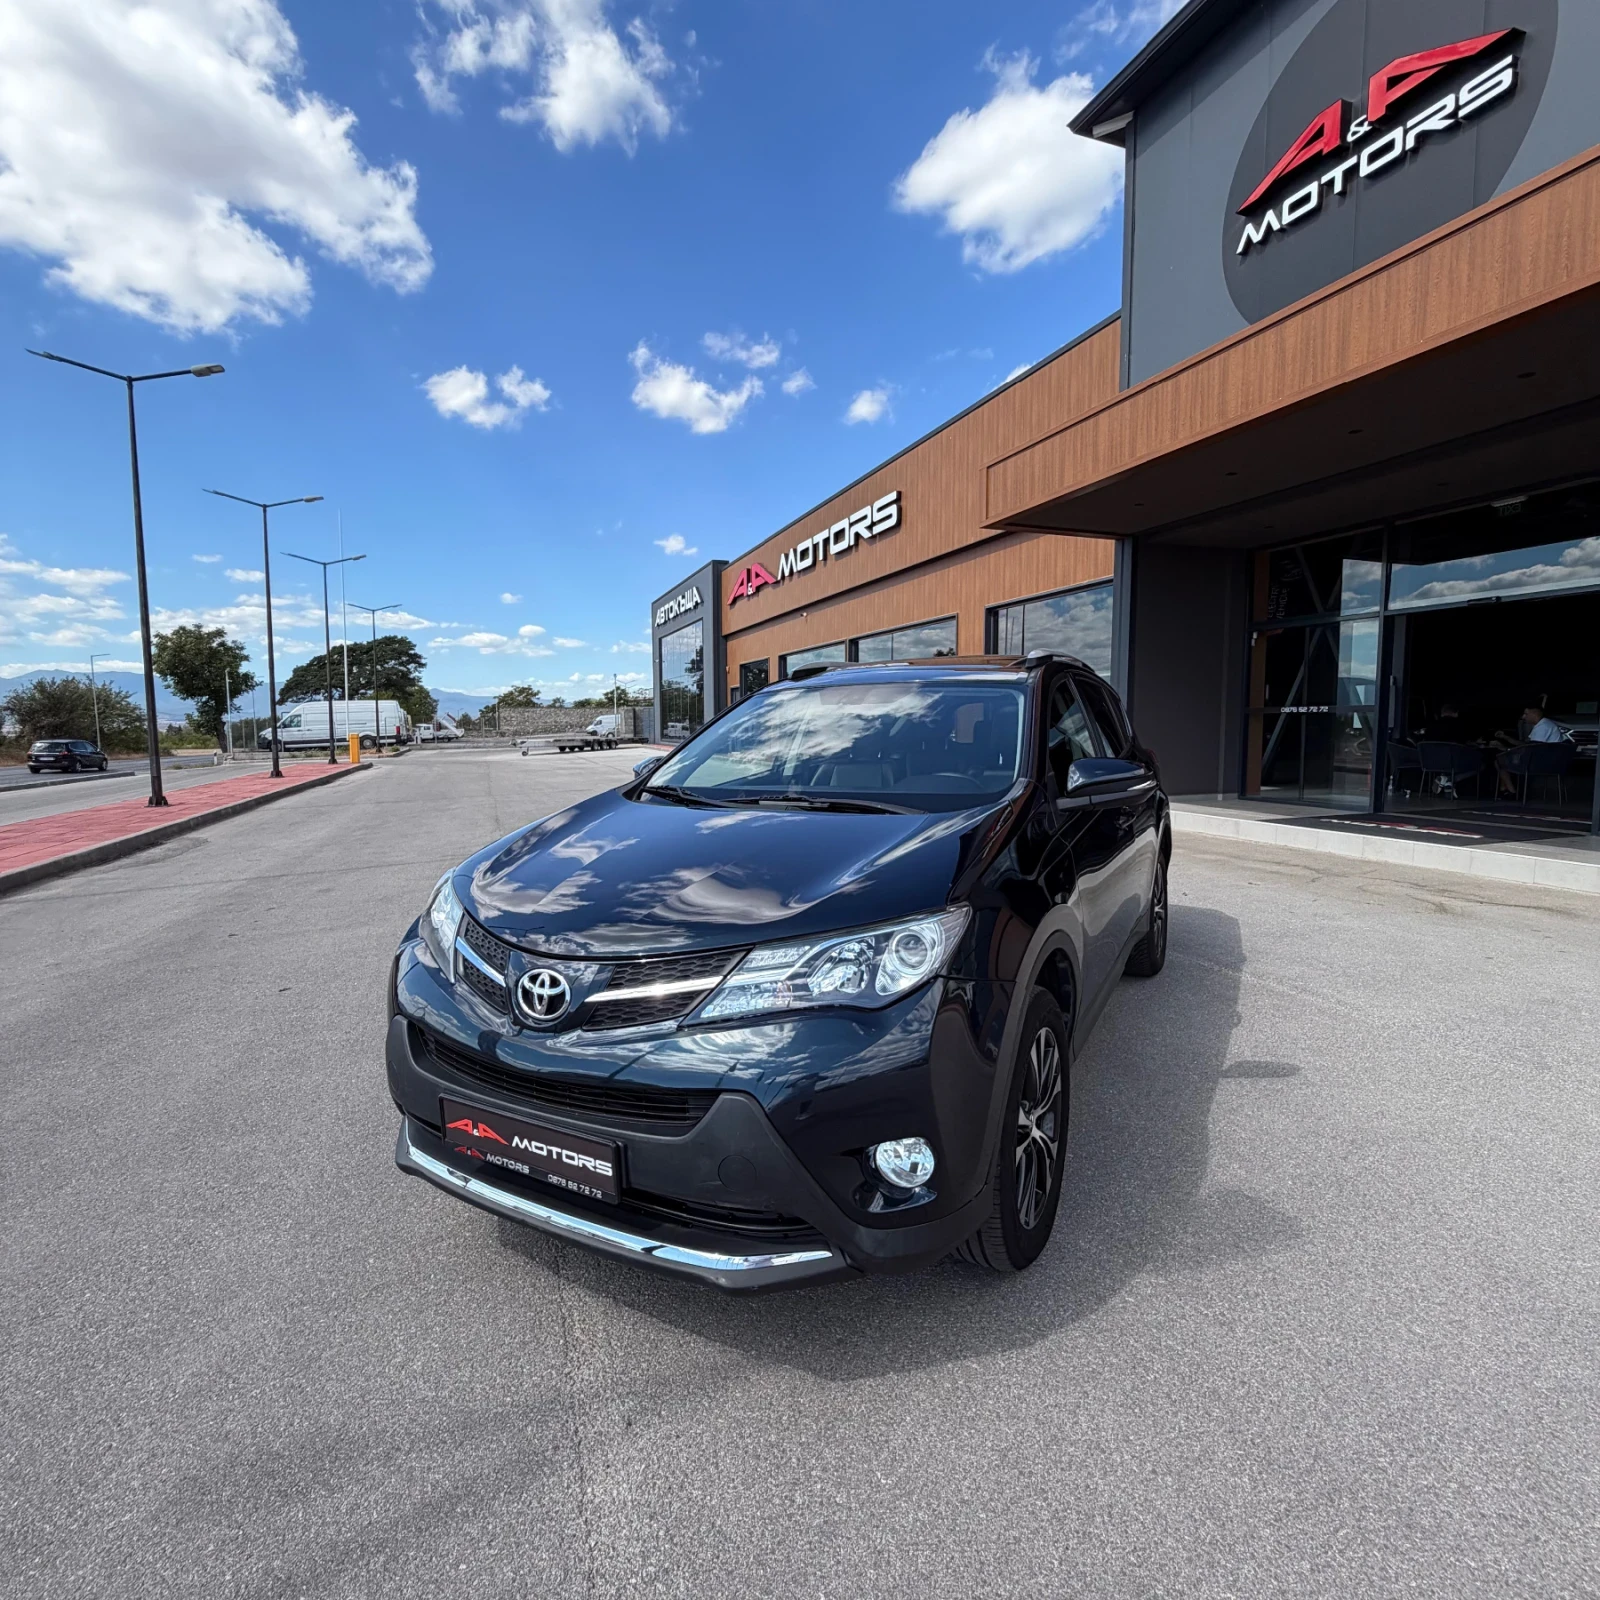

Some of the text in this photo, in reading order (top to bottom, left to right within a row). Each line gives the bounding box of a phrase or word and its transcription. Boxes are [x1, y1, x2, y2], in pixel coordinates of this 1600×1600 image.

[1236, 54, 1517, 255] MOTORS
[727, 490, 900, 606] A&A MOTORS
[655, 586, 702, 627] АВТОКЪЩА
[1319, 705, 1329, 713] 72
[446, 1119, 612, 1177] A&A MOTORS
[454, 1146, 530, 1174] A&A MOTORS
[579, 1184, 590, 1195] 72
[591, 1188, 603, 1199] 72
